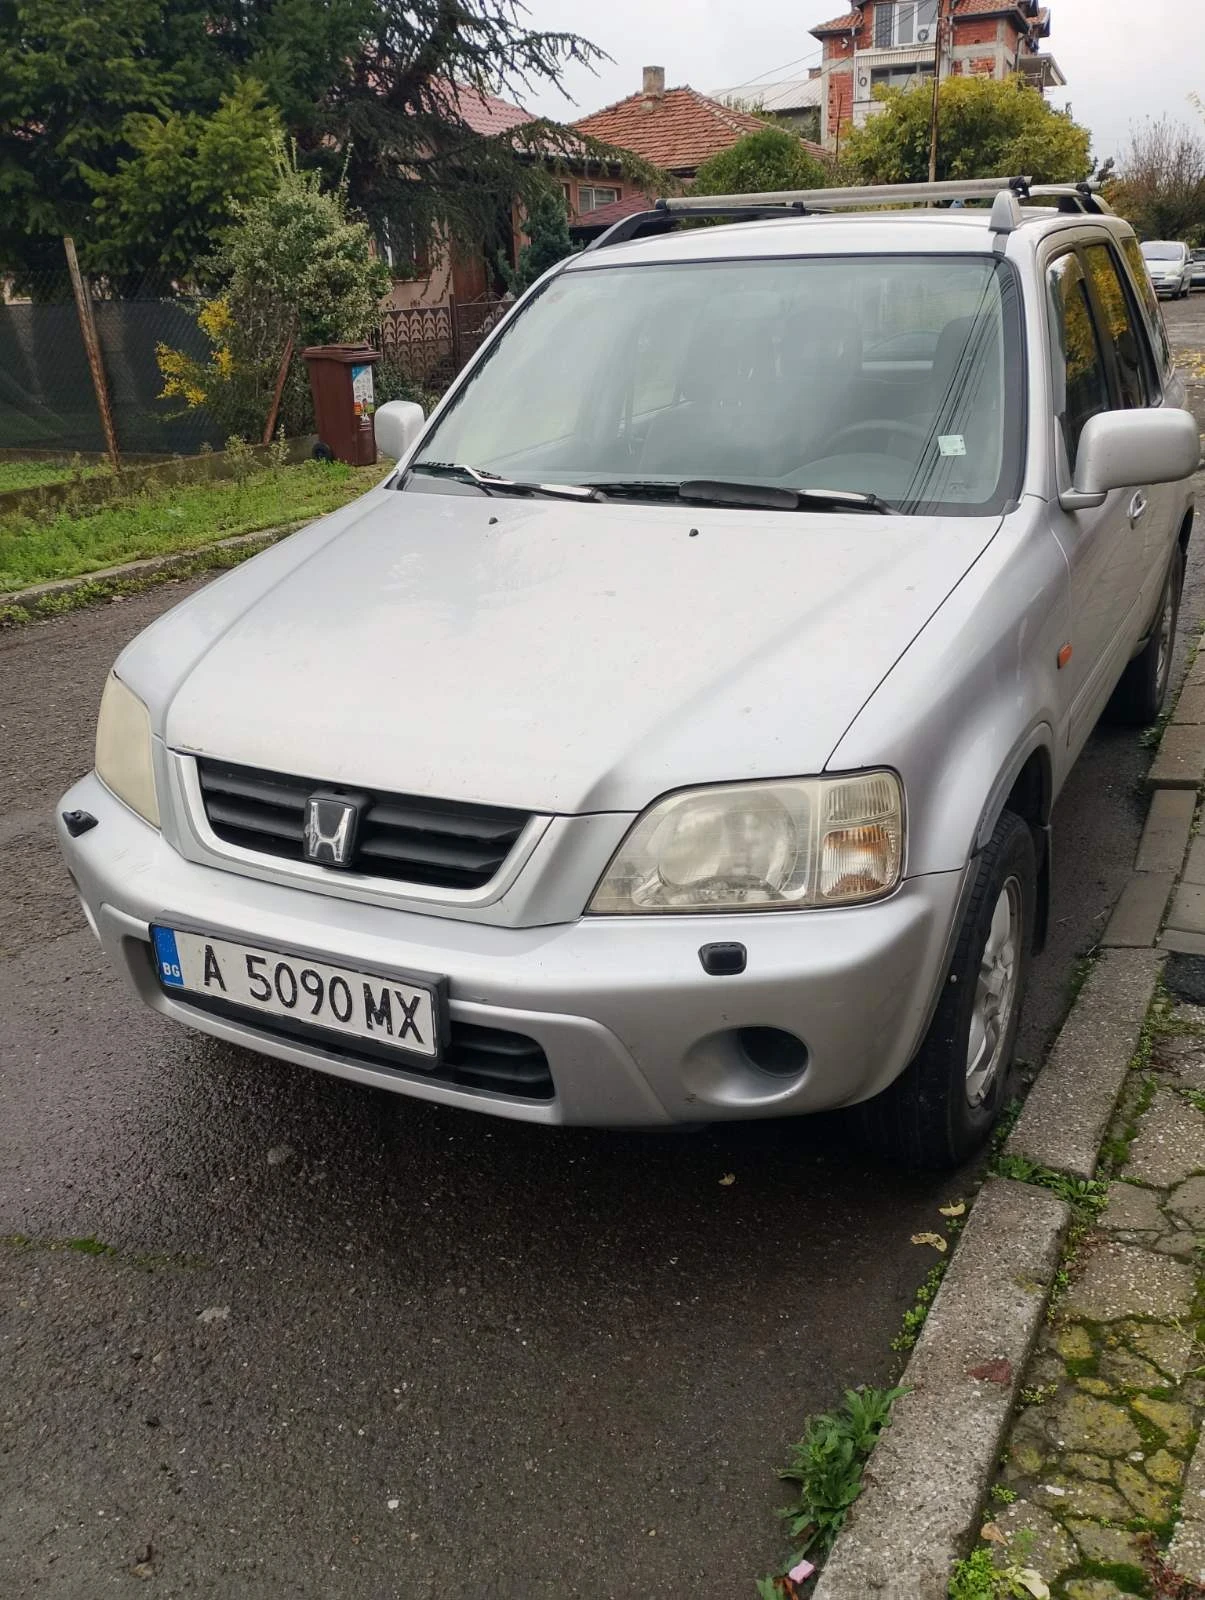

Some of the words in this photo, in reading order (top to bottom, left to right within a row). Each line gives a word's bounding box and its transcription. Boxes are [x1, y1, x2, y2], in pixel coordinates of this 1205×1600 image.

[162, 962, 181, 977] BG
[204, 944, 227, 992] A
[245, 953, 353, 1023] 5090
[362, 982, 425, 1044] MX
